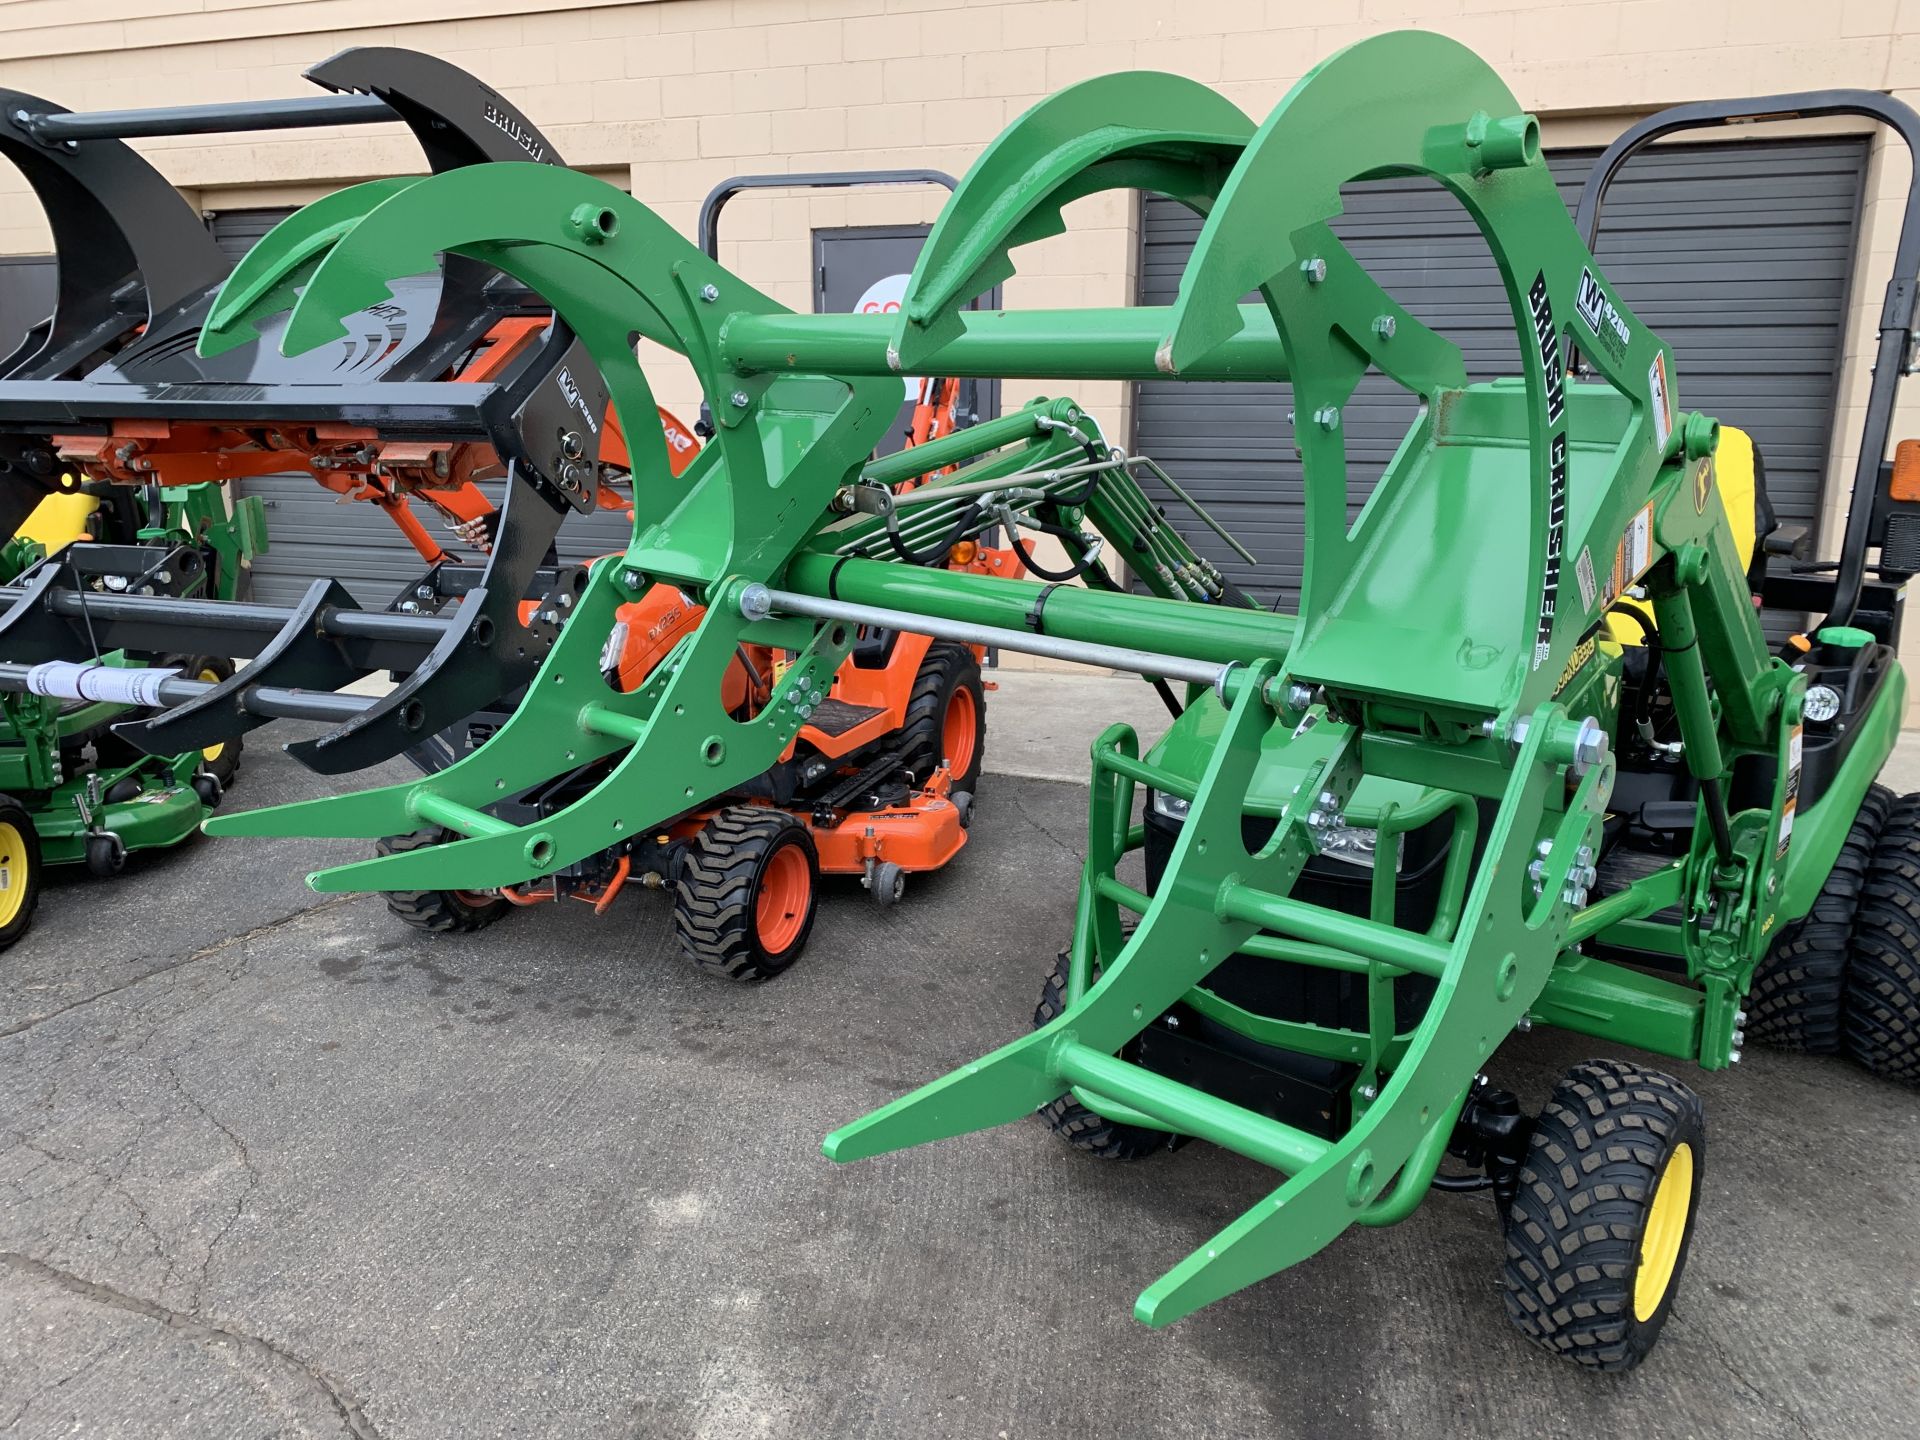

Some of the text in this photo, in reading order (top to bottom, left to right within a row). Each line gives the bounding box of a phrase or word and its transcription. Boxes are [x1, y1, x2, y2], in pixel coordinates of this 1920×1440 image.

[484, 101, 543, 161] BRUSH
[1527, 268, 1564, 428] BRUSH
[1605, 302, 1630, 345] 4200
[1536, 431, 1566, 645] CRUSHER
